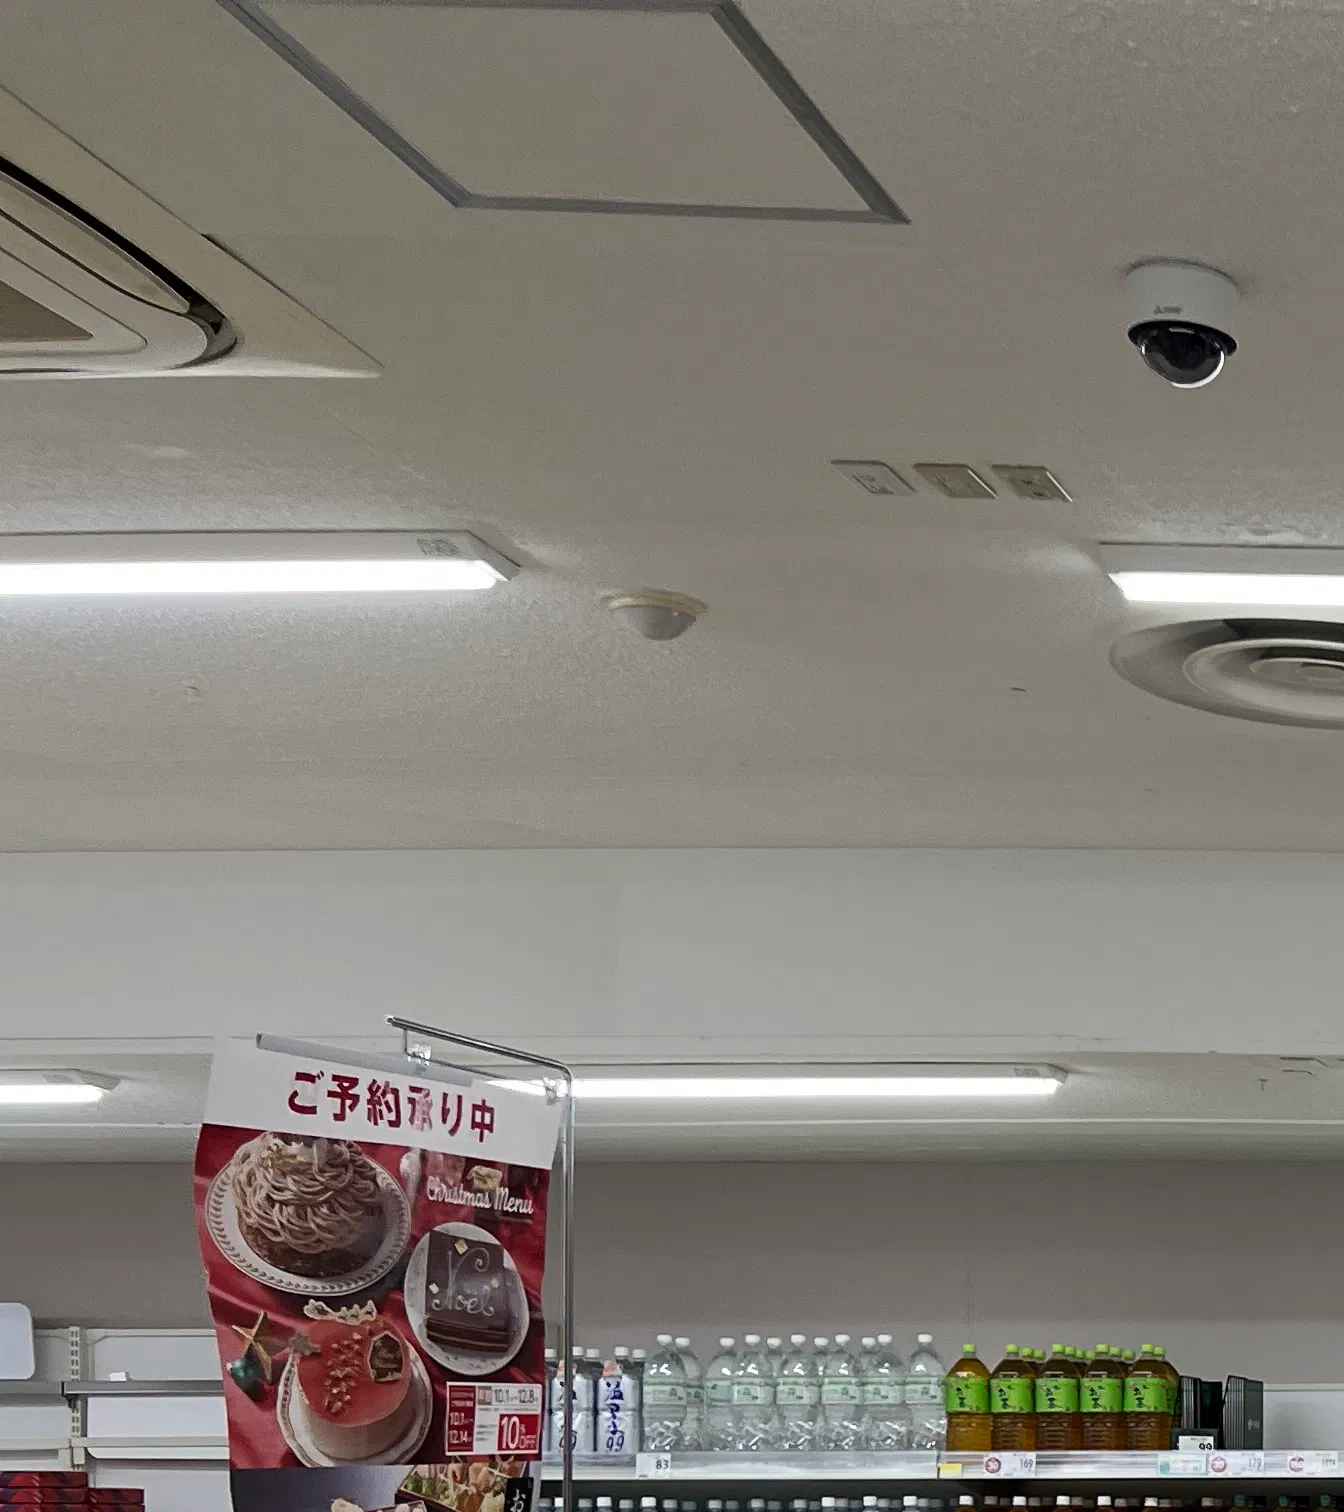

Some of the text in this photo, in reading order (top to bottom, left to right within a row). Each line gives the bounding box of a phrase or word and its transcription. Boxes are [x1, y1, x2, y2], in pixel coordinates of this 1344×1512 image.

[287, 1070, 496, 1143] ご予約承り中
[426, 1175, 535, 1214] Christmas Menu
[655, 1459, 670, 1470] 83
